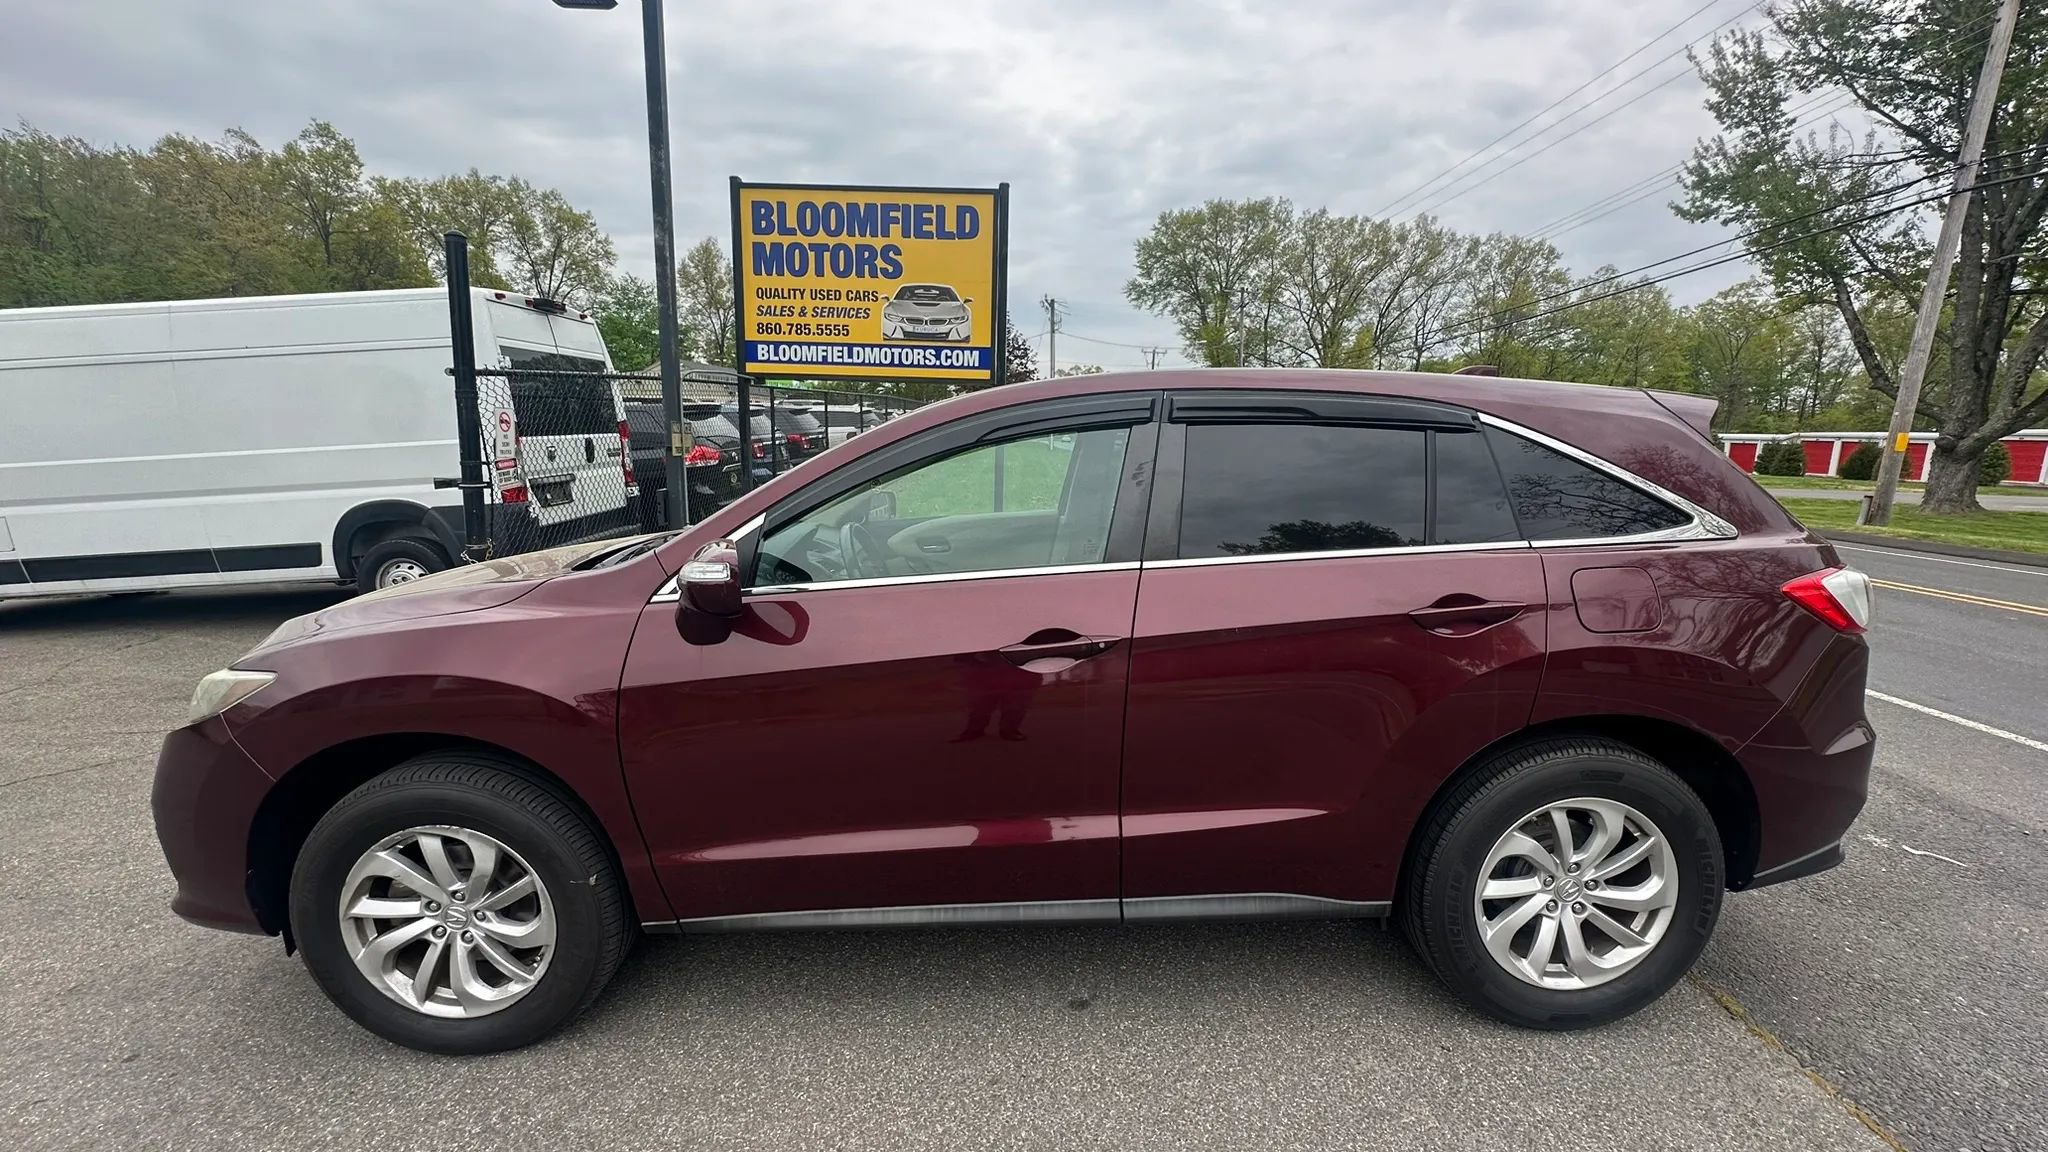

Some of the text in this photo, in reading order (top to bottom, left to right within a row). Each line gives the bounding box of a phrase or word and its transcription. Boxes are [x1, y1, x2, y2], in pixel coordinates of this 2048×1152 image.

[751, 200, 980, 240] BLOOMFIELD
[752, 242, 903, 279] MOTORS
[756, 287, 879, 302] QUALITY USED CARS
[756, 305, 871, 319] SALES & SERVICES
[756, 322, 850, 337] 860.785.5555
[757, 343, 980, 367] BLOOMFIELDMOTORS.COM
